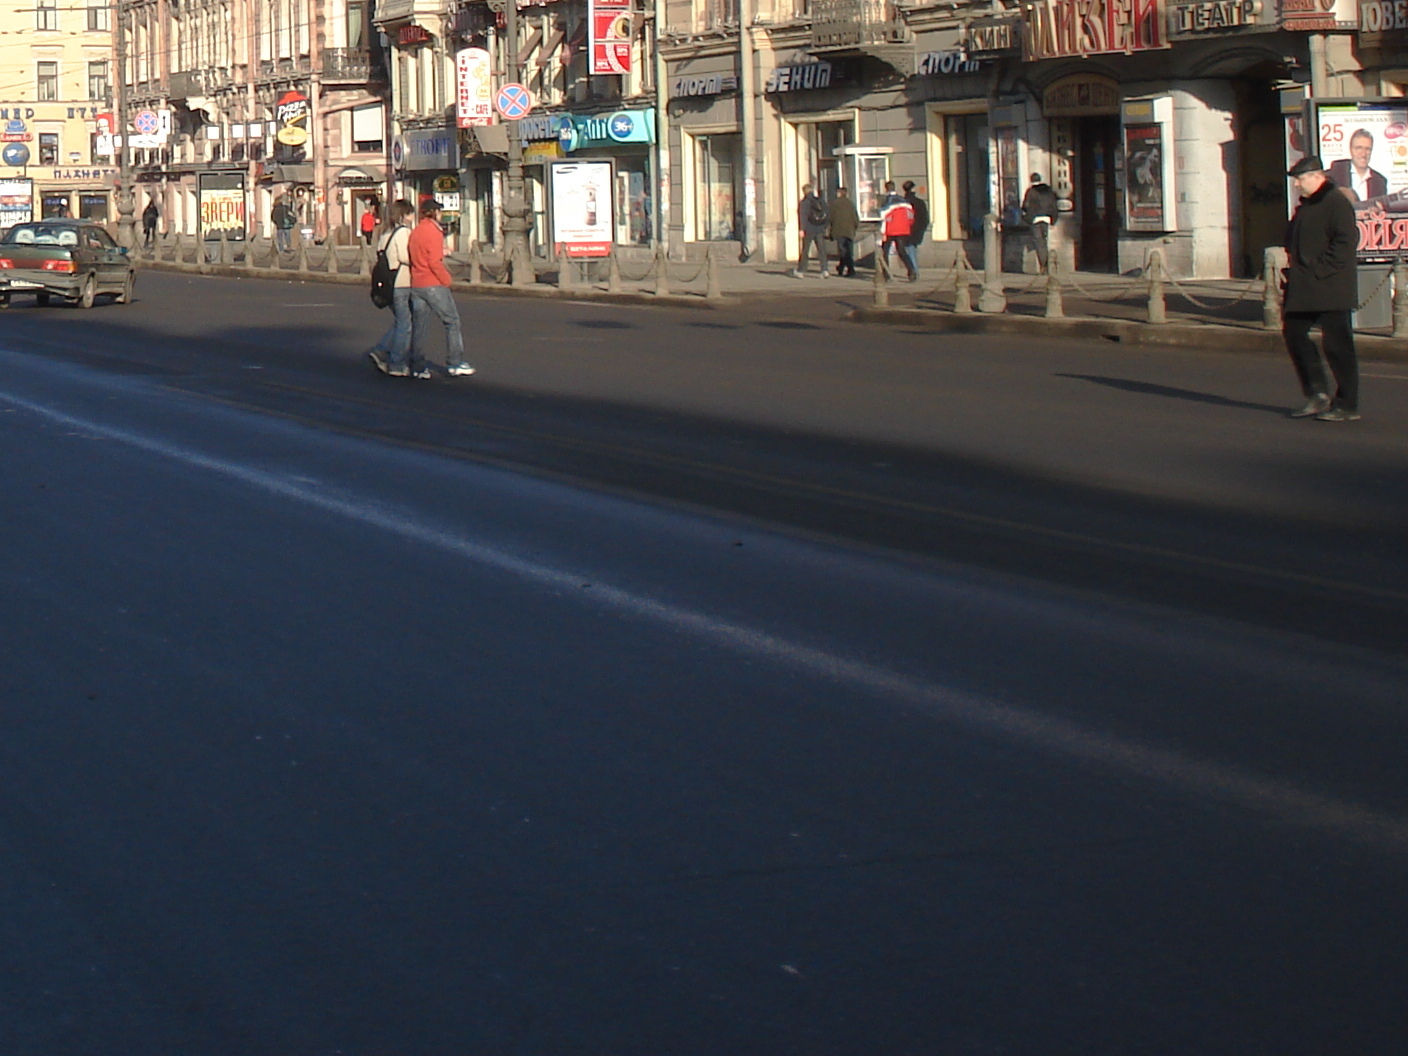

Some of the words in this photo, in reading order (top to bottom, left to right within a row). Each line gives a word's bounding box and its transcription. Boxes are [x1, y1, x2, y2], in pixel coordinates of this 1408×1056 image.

[1177, 0, 1261, 31] ТЕАТР
[766, 62, 832, 93] ЗЕНИТ
[1321, 123, 1344, 142] 25
